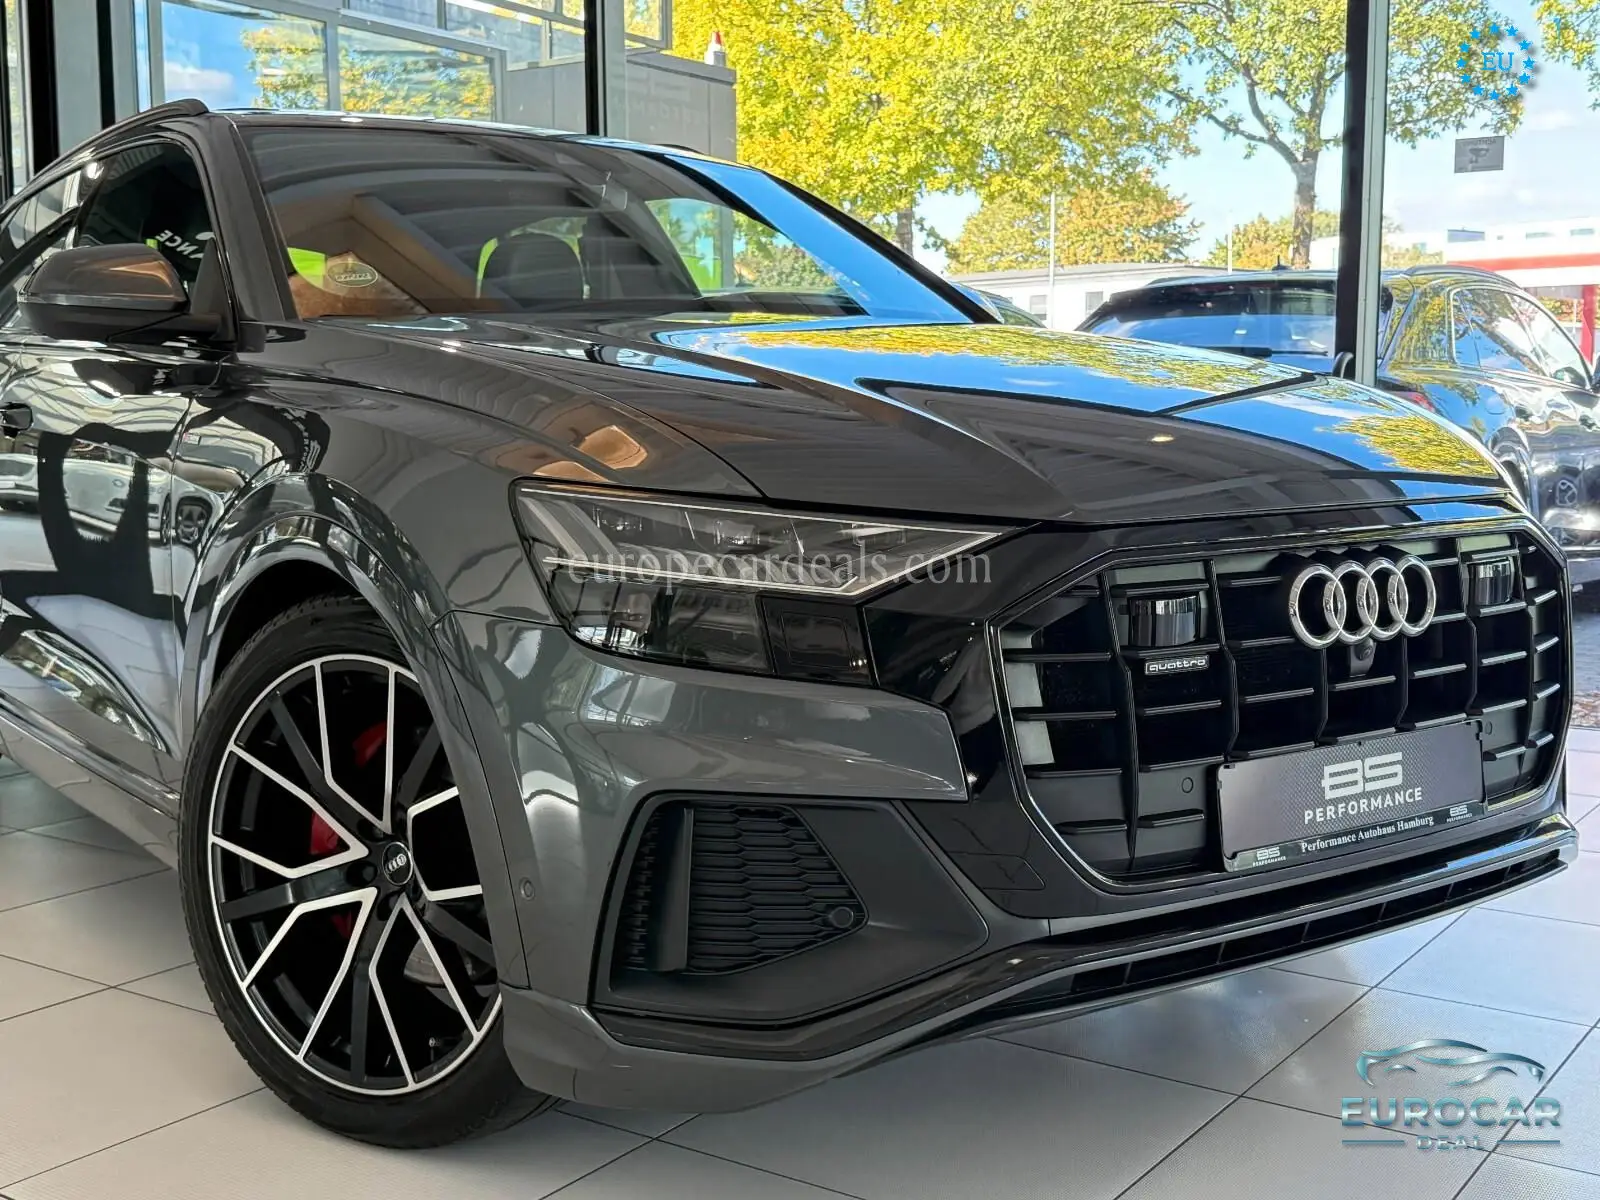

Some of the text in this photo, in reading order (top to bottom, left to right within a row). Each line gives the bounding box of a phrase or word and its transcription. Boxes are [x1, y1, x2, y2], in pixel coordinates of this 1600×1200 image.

[1149, 659, 1206, 672] quattro
[1304, 787, 1422, 825] PERFORMANCE
[1301, 816, 1435, 853] Performance Autohaus Hamburg
